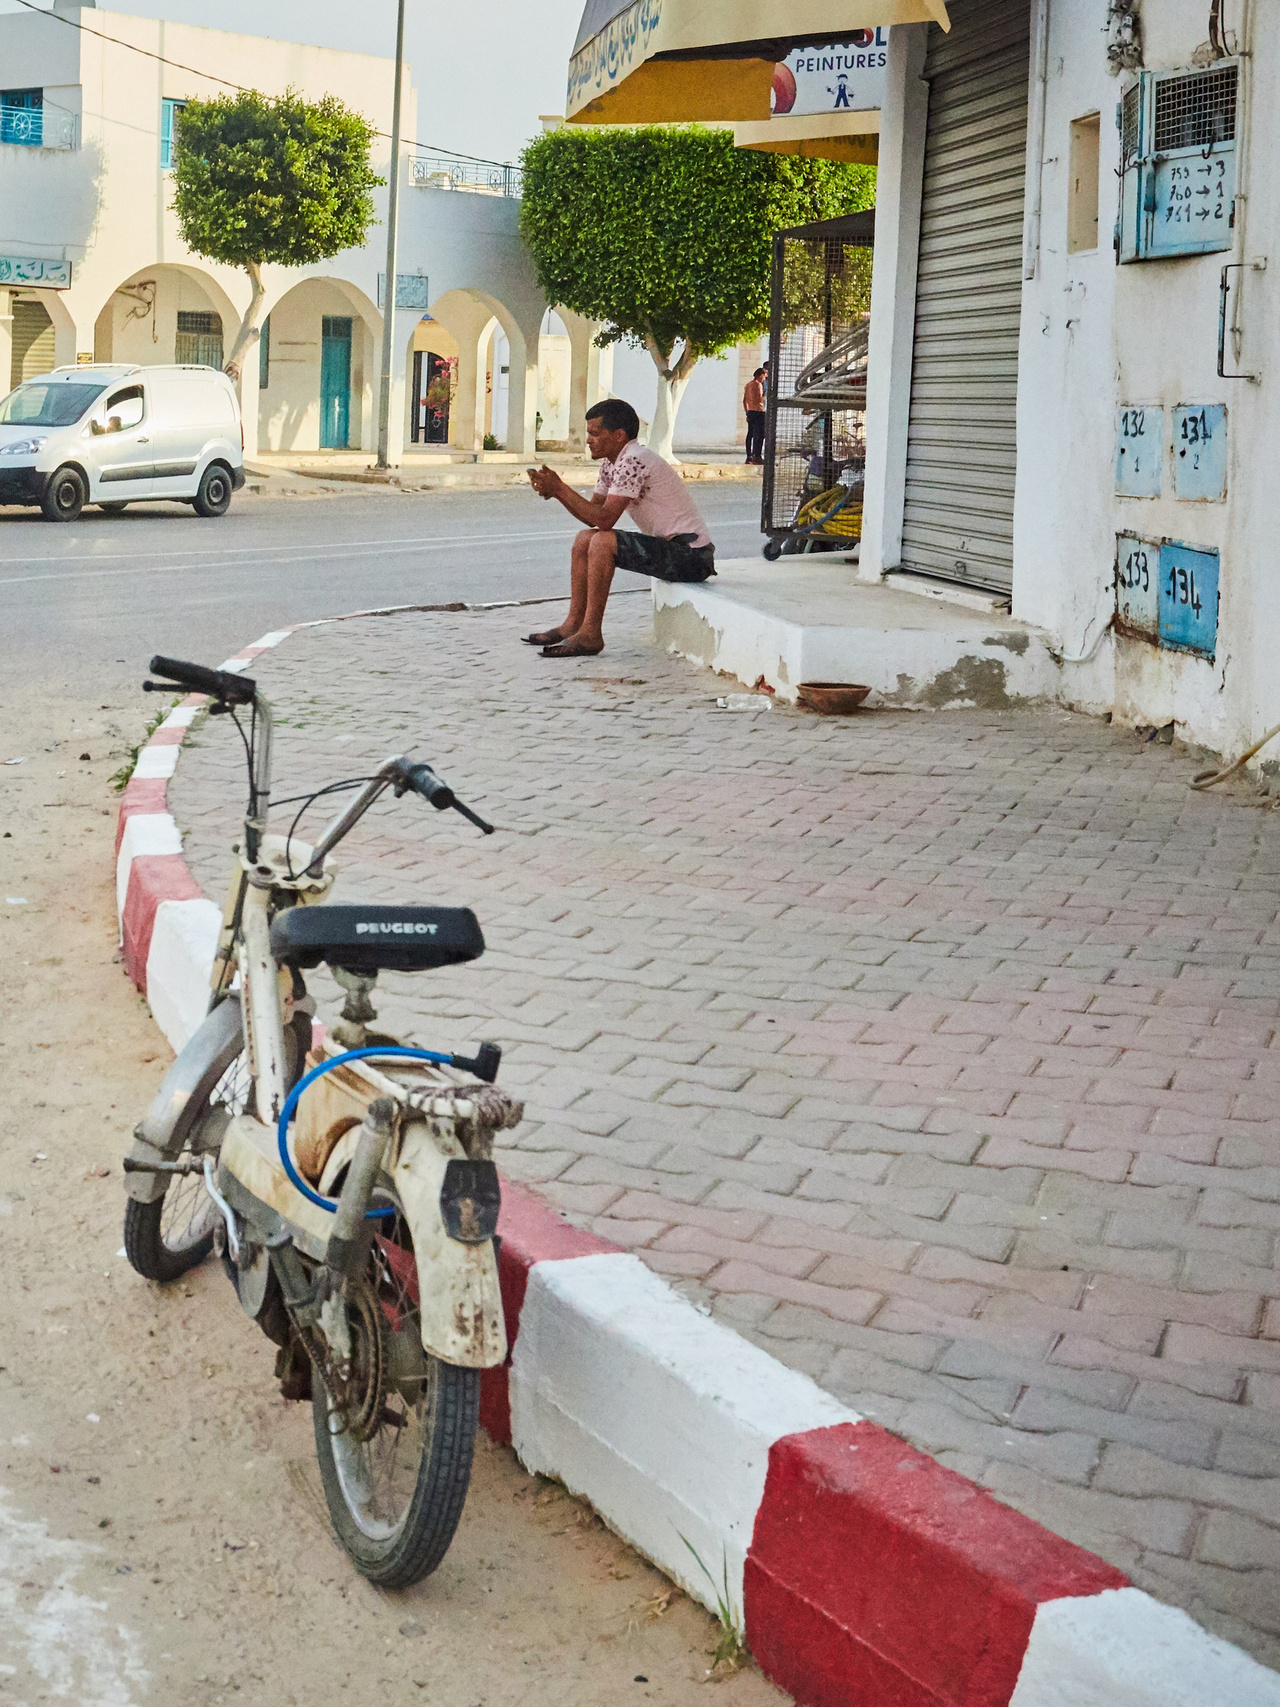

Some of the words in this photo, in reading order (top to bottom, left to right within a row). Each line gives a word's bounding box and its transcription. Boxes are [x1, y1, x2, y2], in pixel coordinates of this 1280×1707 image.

[795, 52, 887, 73] PEINTURES
[1215, 160, 1225, 178] 3
[1214, 202, 1223, 219] 2
[1122, 410, 1145, 438] 132
[1126, 551, 1150, 593] 133
[1169, 566, 1203, 620] 134
[355, 922, 439, 935] PEUGEOT
